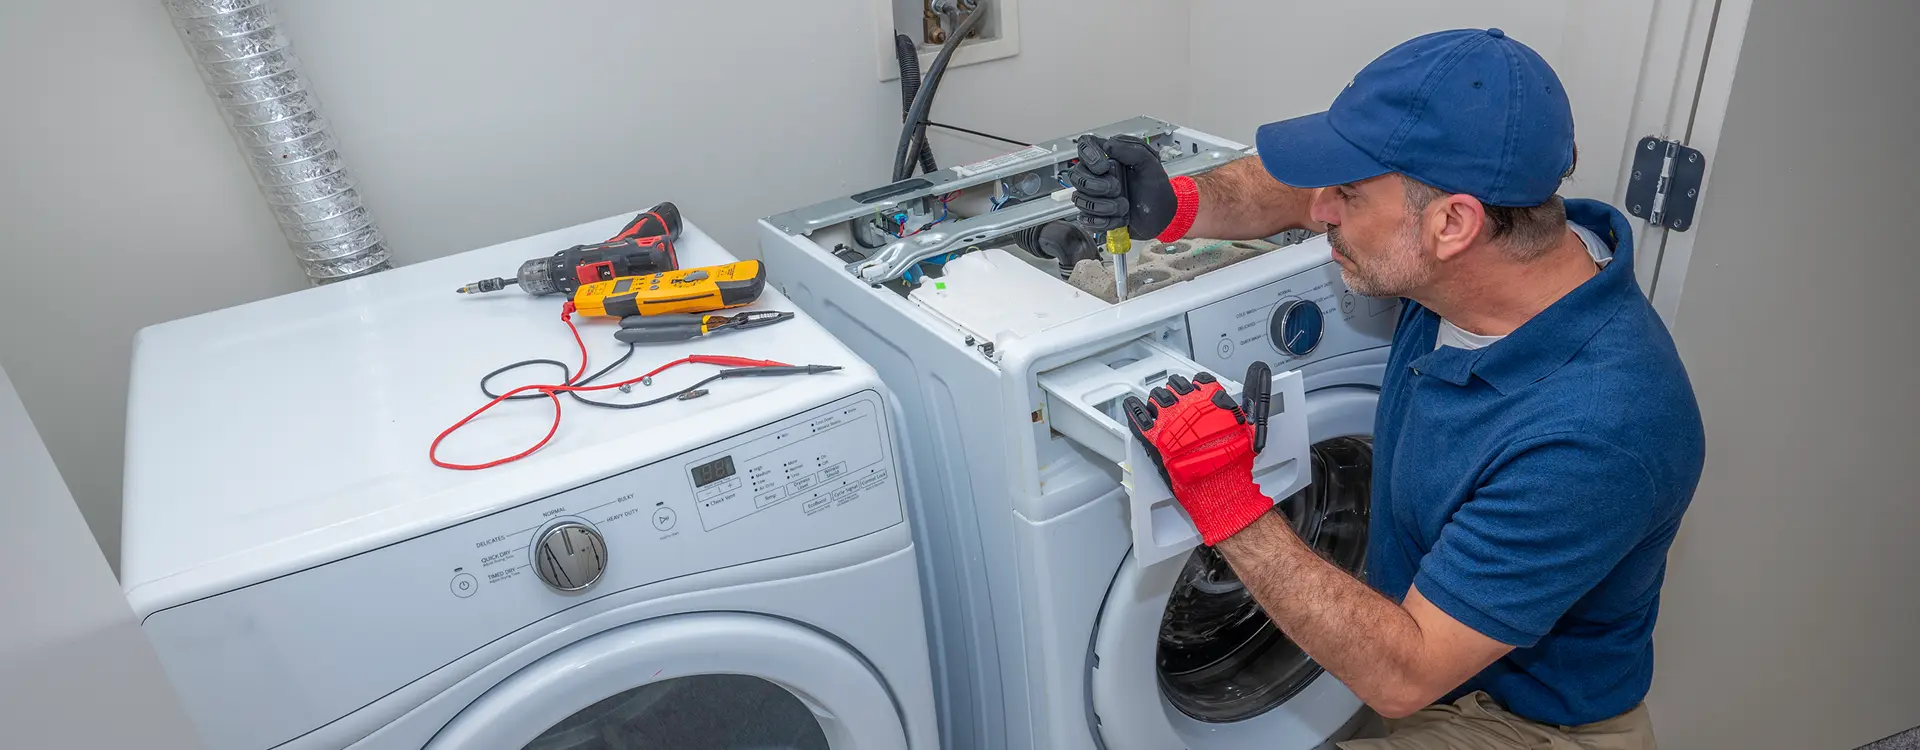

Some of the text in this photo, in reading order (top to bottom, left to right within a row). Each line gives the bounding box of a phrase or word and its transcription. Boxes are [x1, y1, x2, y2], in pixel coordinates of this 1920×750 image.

[617, 493, 635, 503] BULKY
[542, 506, 567, 518] NORMAL
[606, 508, 639, 523] HEAVY DUTY
[476, 535, 505, 548] DELICATES
[481, 550, 511, 563] QUICK DRY
[488, 571, 504, 580] TIMED
